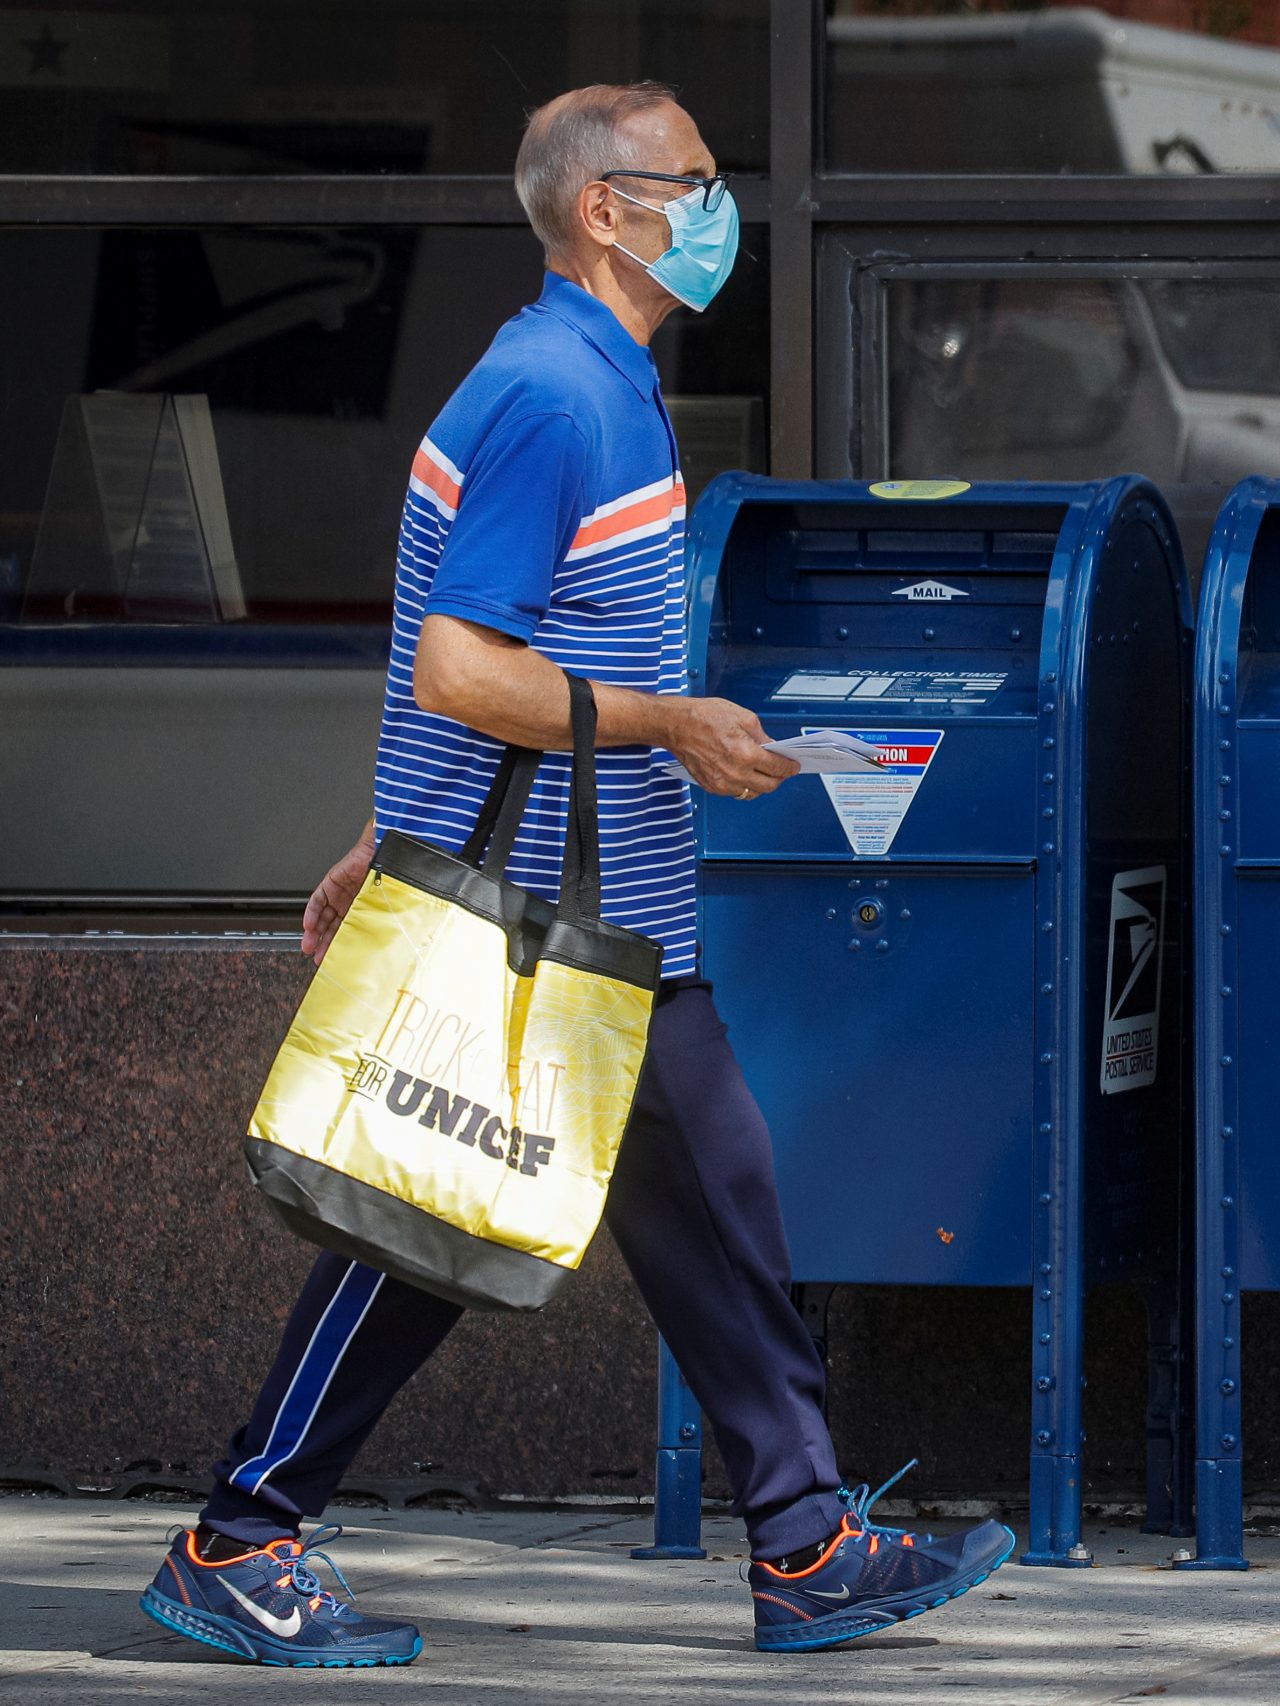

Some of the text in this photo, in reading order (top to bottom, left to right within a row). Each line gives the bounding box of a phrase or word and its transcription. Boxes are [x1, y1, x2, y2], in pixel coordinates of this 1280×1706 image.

[913, 588, 946, 598] MAIL
[848, 670, 954, 678] COLLECTION
[375, 988, 486, 1089] TRICK
[1107, 1028, 1152, 1054] UNITED STATES
[1105, 1052, 1153, 1080] POSTAL SERVICE
[351, 1058, 556, 1177] FOR UNICEF
